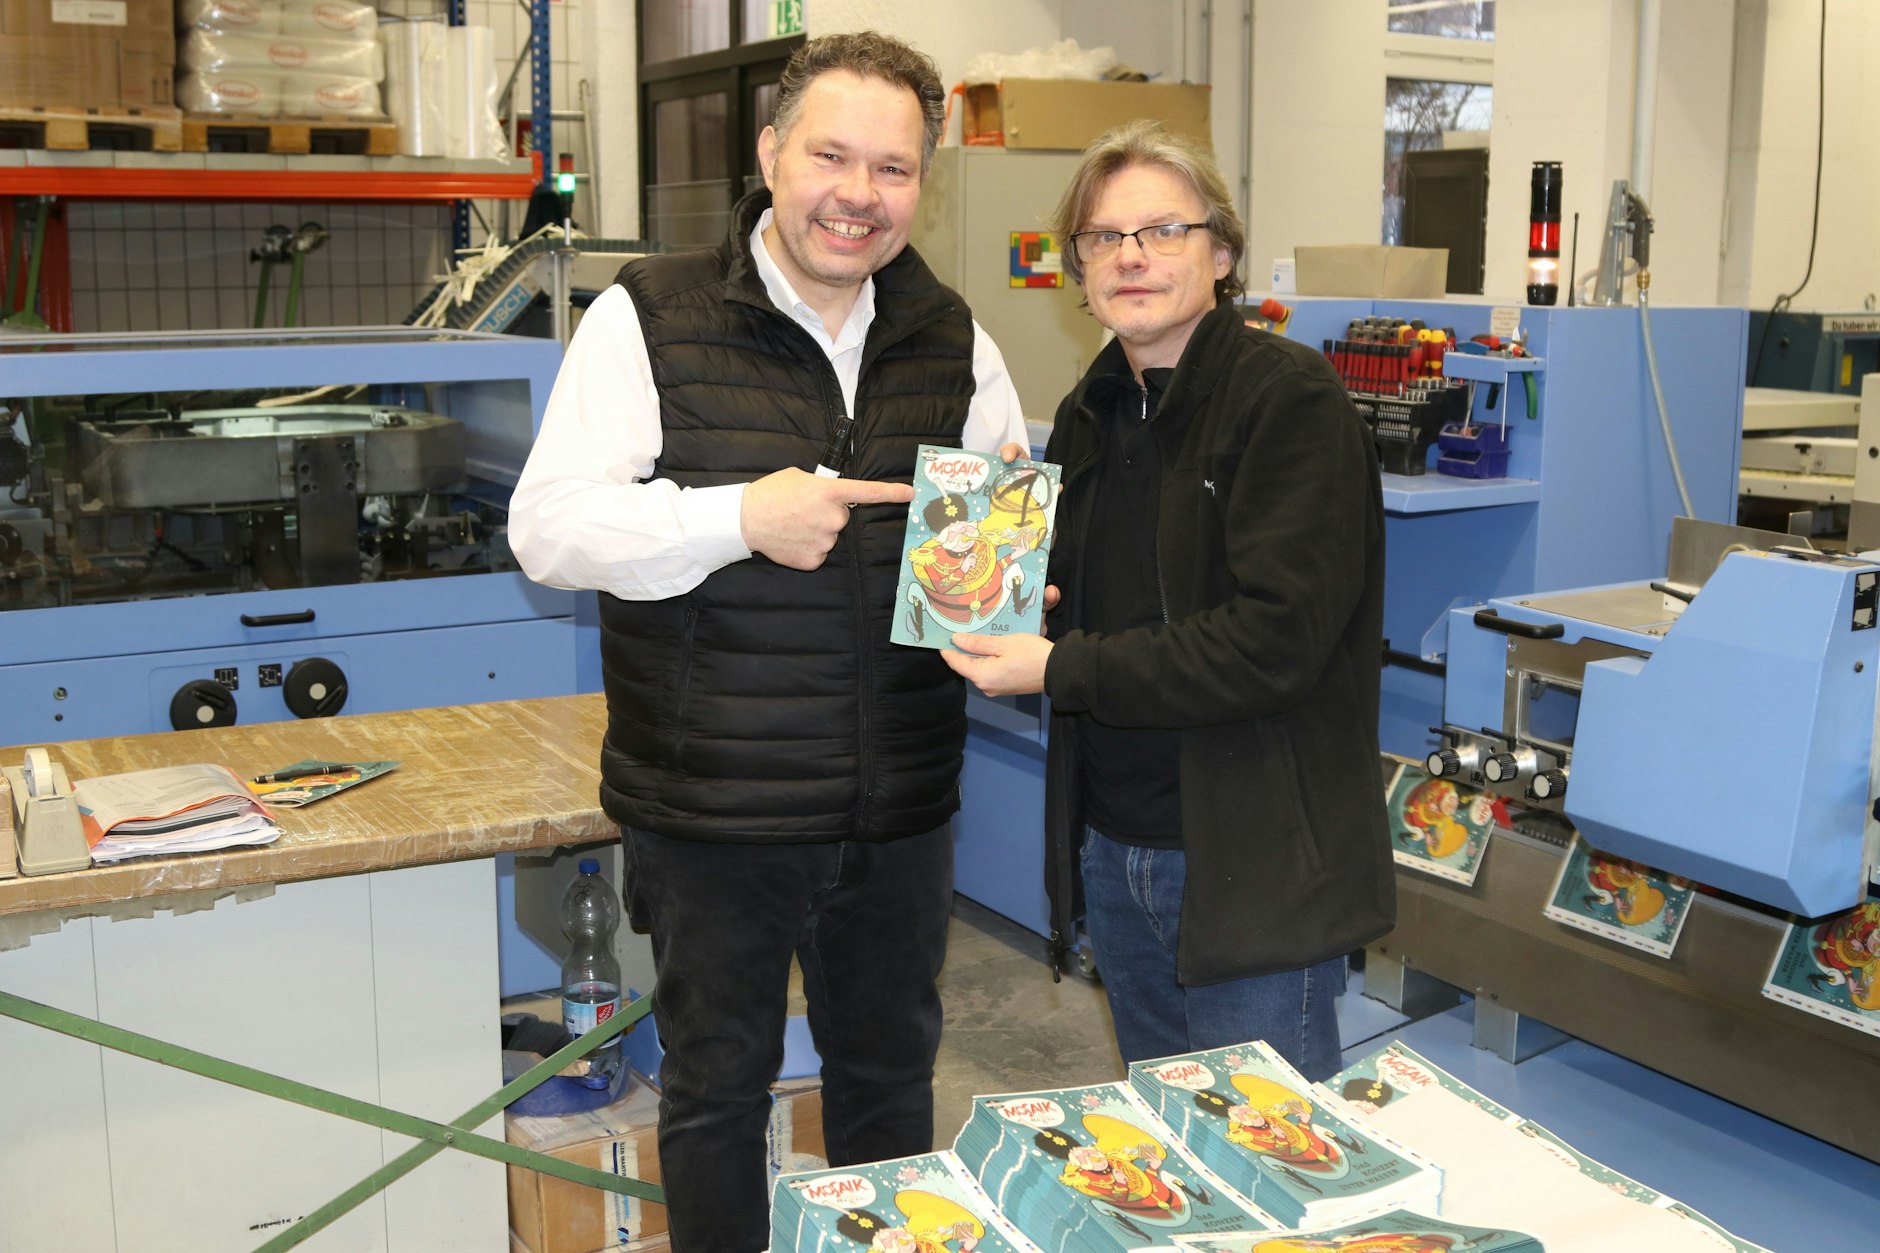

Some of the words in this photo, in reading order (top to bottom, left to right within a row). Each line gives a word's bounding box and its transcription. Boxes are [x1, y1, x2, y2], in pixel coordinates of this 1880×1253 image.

[928, 460, 986, 478] MOSAIK
[991, 623, 1010, 632] DAS
[1160, 1063, 1207, 1082] MOSAIK
[1380, 1057, 1434, 1088] MOSAIK
[1003, 1101, 1057, 1118] MOSAIK
[1352, 1161, 1372, 1171] DAS
[1361, 1159, 1401, 1177] KONZERT
[808, 1178, 869, 1199] MOSAIK
[1194, 1212, 1216, 1221] DAS
[1203, 1214, 1248, 1228] KONZERT
